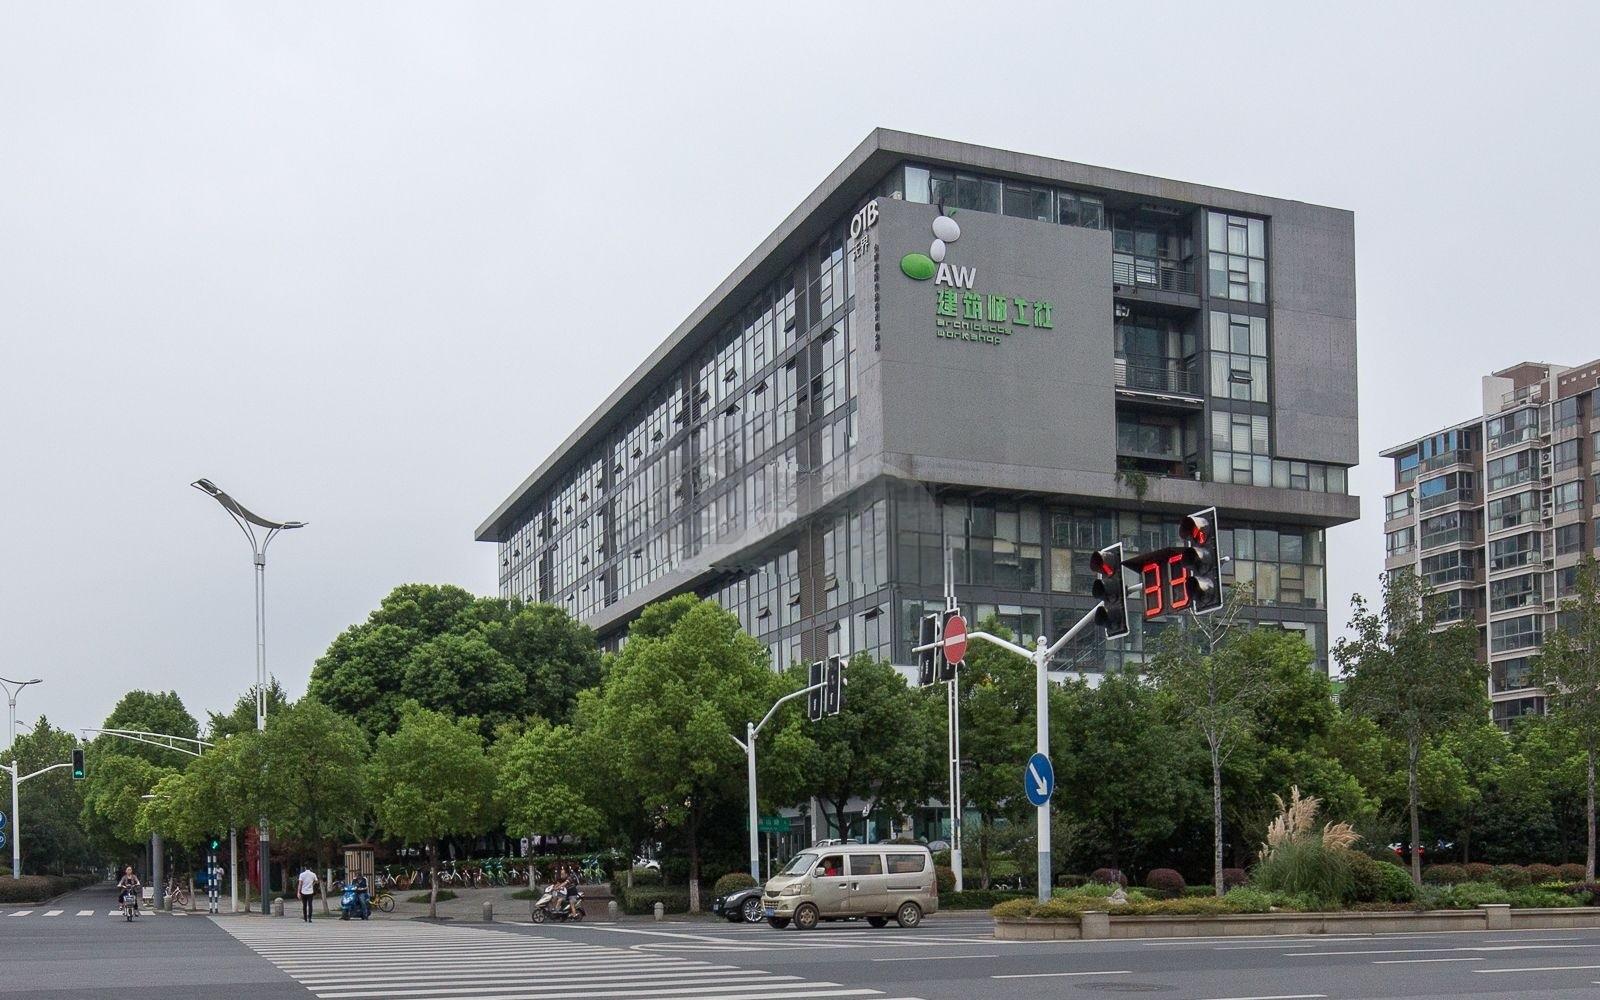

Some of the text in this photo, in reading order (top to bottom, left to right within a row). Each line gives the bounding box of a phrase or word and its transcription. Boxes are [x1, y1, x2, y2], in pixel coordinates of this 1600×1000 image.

[850, 199, 878, 238] OTB
[935, 263, 976, 288] AW
[936, 289, 1053, 329] 建筑师工社
[937, 329, 1002, 345] workshop
[1142, 553, 1188, 616] 33
